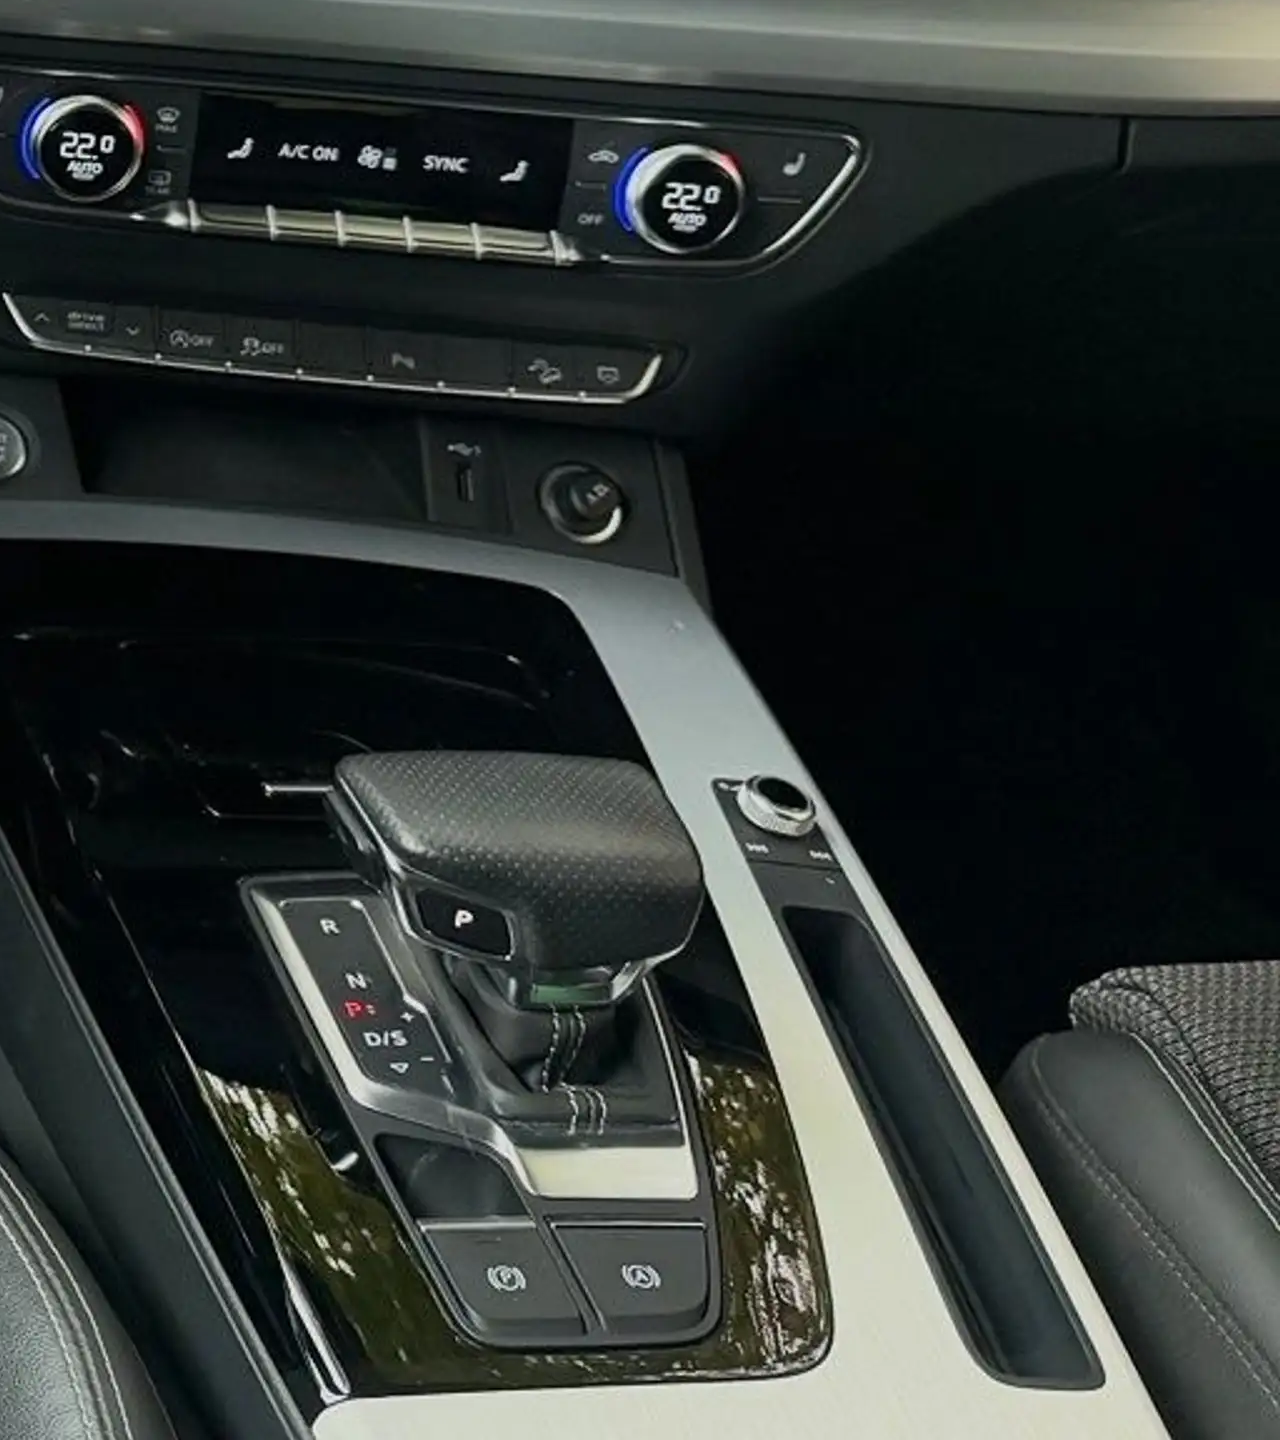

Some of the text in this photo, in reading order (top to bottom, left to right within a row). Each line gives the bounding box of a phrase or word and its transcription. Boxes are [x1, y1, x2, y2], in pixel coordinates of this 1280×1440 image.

[277, 142, 339, 162] A/C ON
[422, 155, 470, 174] SYNC
[576, 213, 605, 226] OFF
[319, 918, 341, 935] R
[454, 909, 474, 928] P
[344, 971, 368, 990] N
